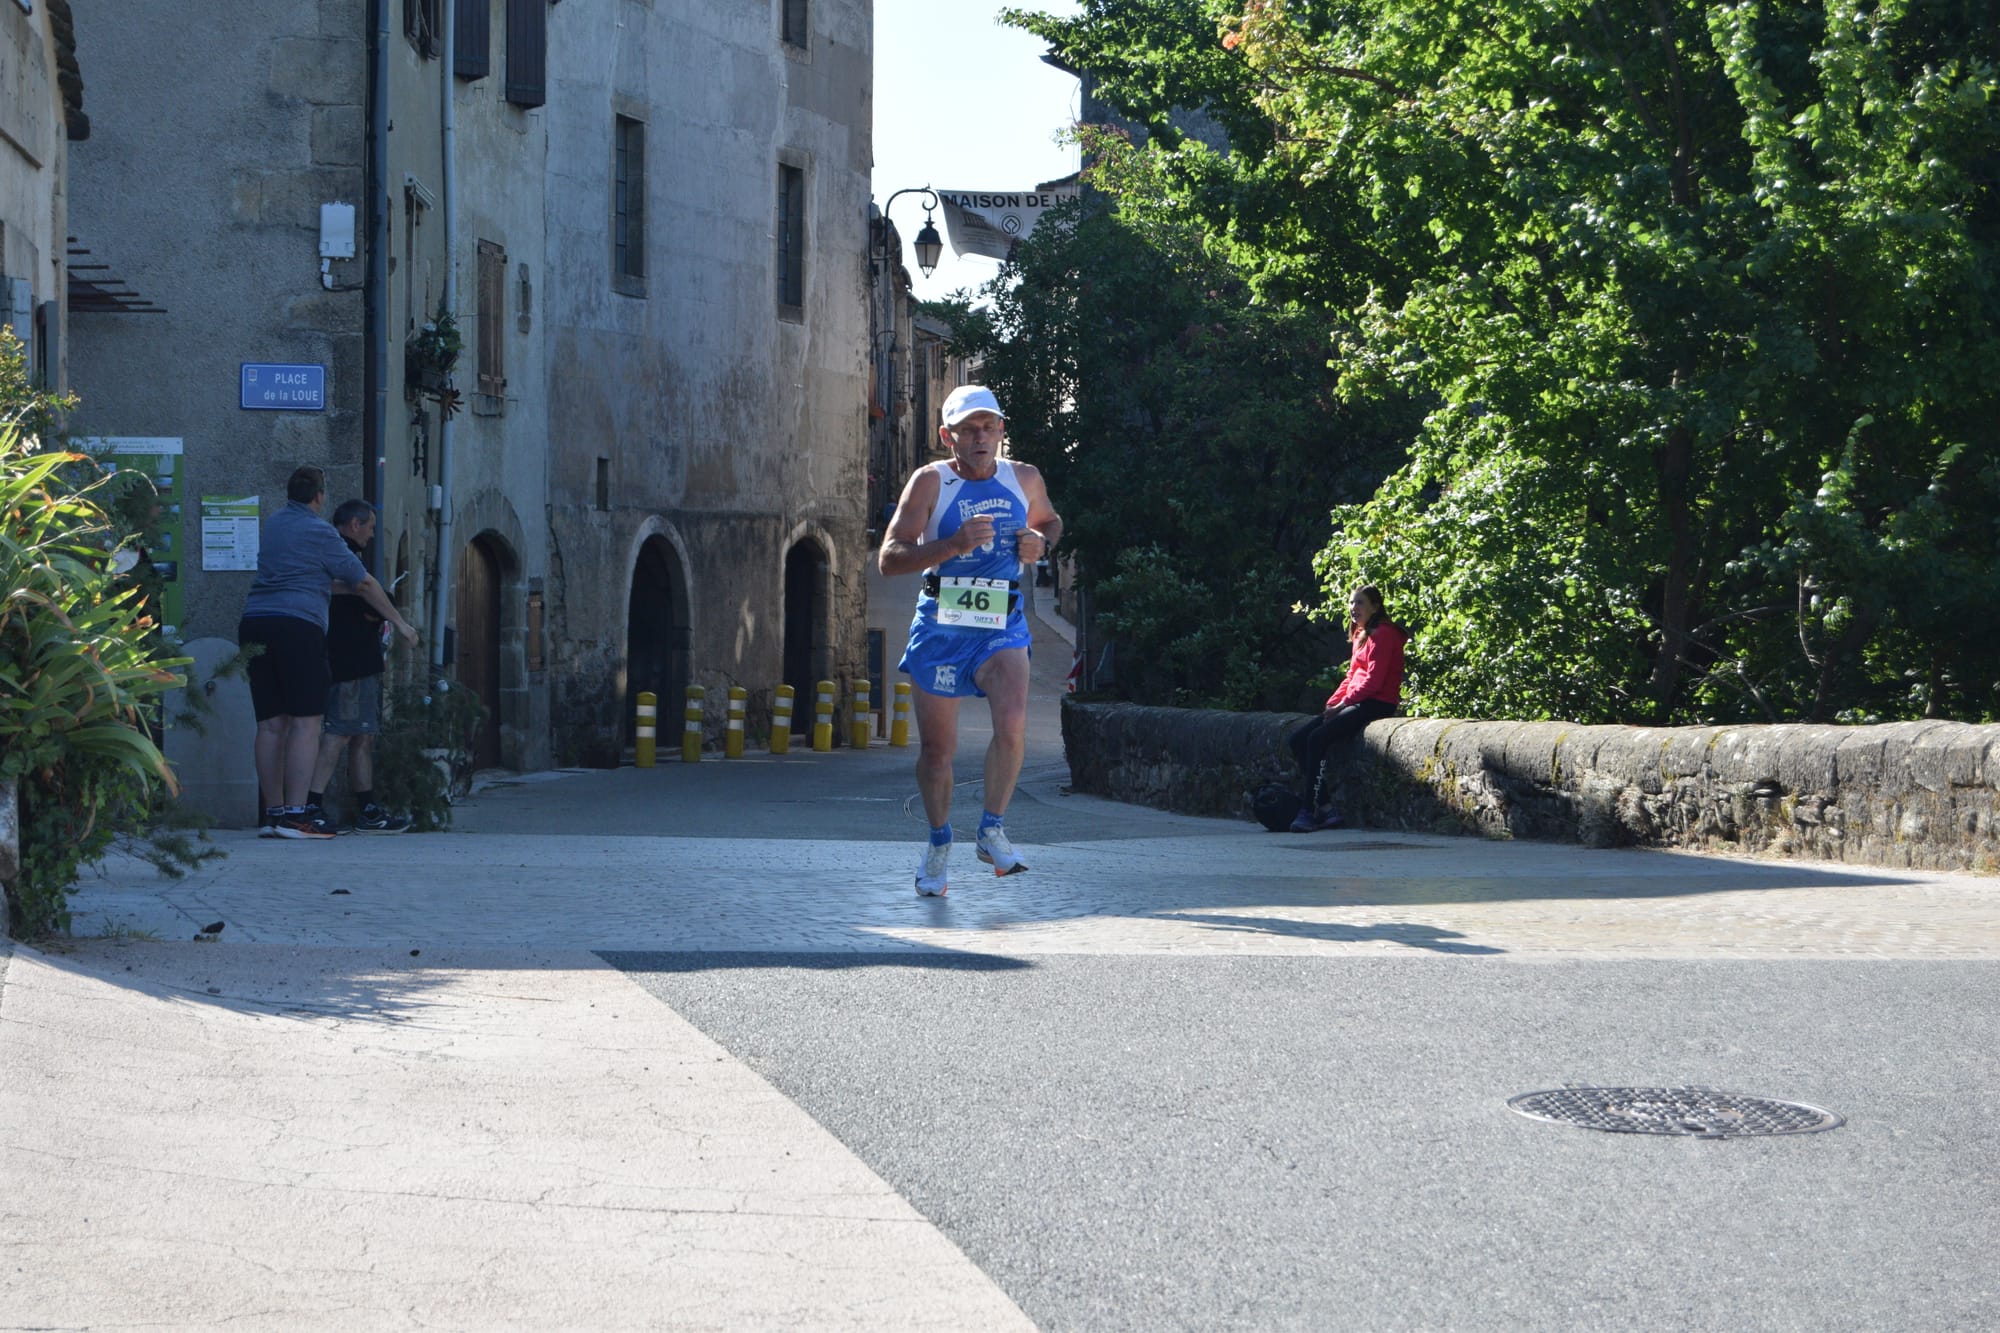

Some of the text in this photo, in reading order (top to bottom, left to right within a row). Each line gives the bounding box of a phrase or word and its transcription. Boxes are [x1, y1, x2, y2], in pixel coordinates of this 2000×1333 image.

[942, 194, 1020, 208] MAISON
[1026, 194, 1050, 207] DE
[274, 373, 308, 385] PLACE
[264, 390, 319, 401] de la LOUE
[957, 590, 990, 611] 46
